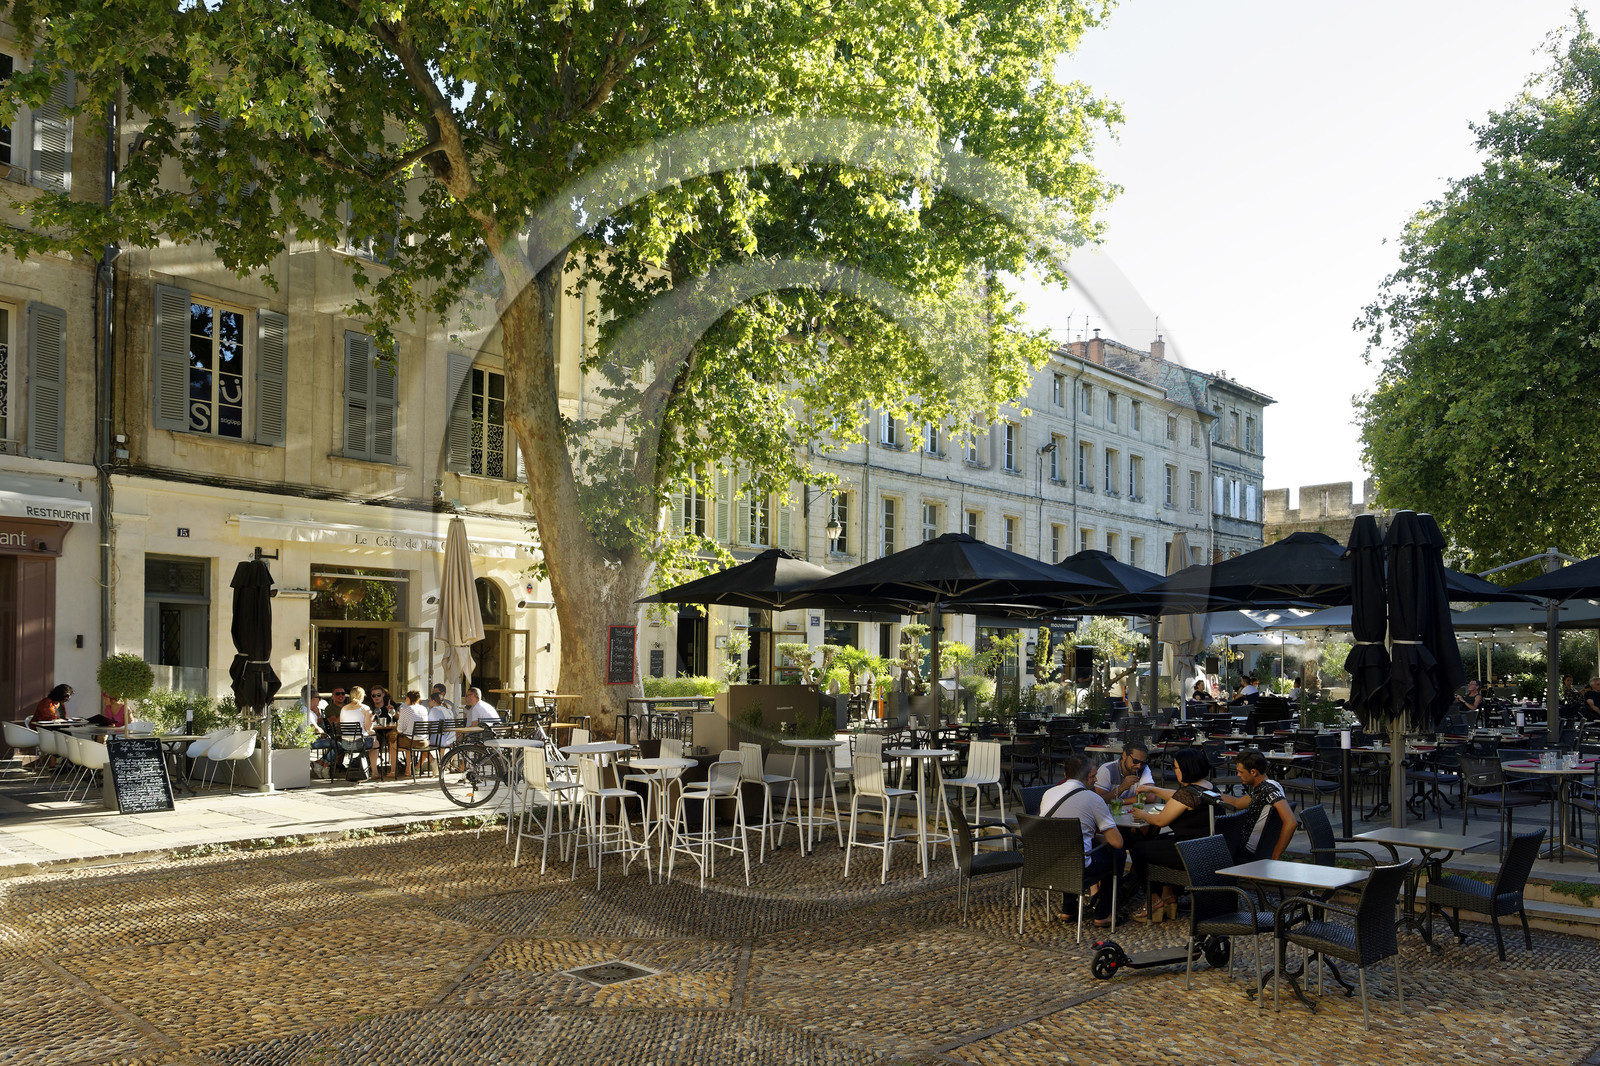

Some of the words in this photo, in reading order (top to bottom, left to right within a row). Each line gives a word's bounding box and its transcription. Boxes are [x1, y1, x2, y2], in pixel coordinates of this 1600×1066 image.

[26, 505, 91, 521] RESTAURANT
[355, 534, 367, 545] Le
[375, 535, 398, 548] Café
[405, 538, 417, 549] de
[425, 540, 433, 550] la
